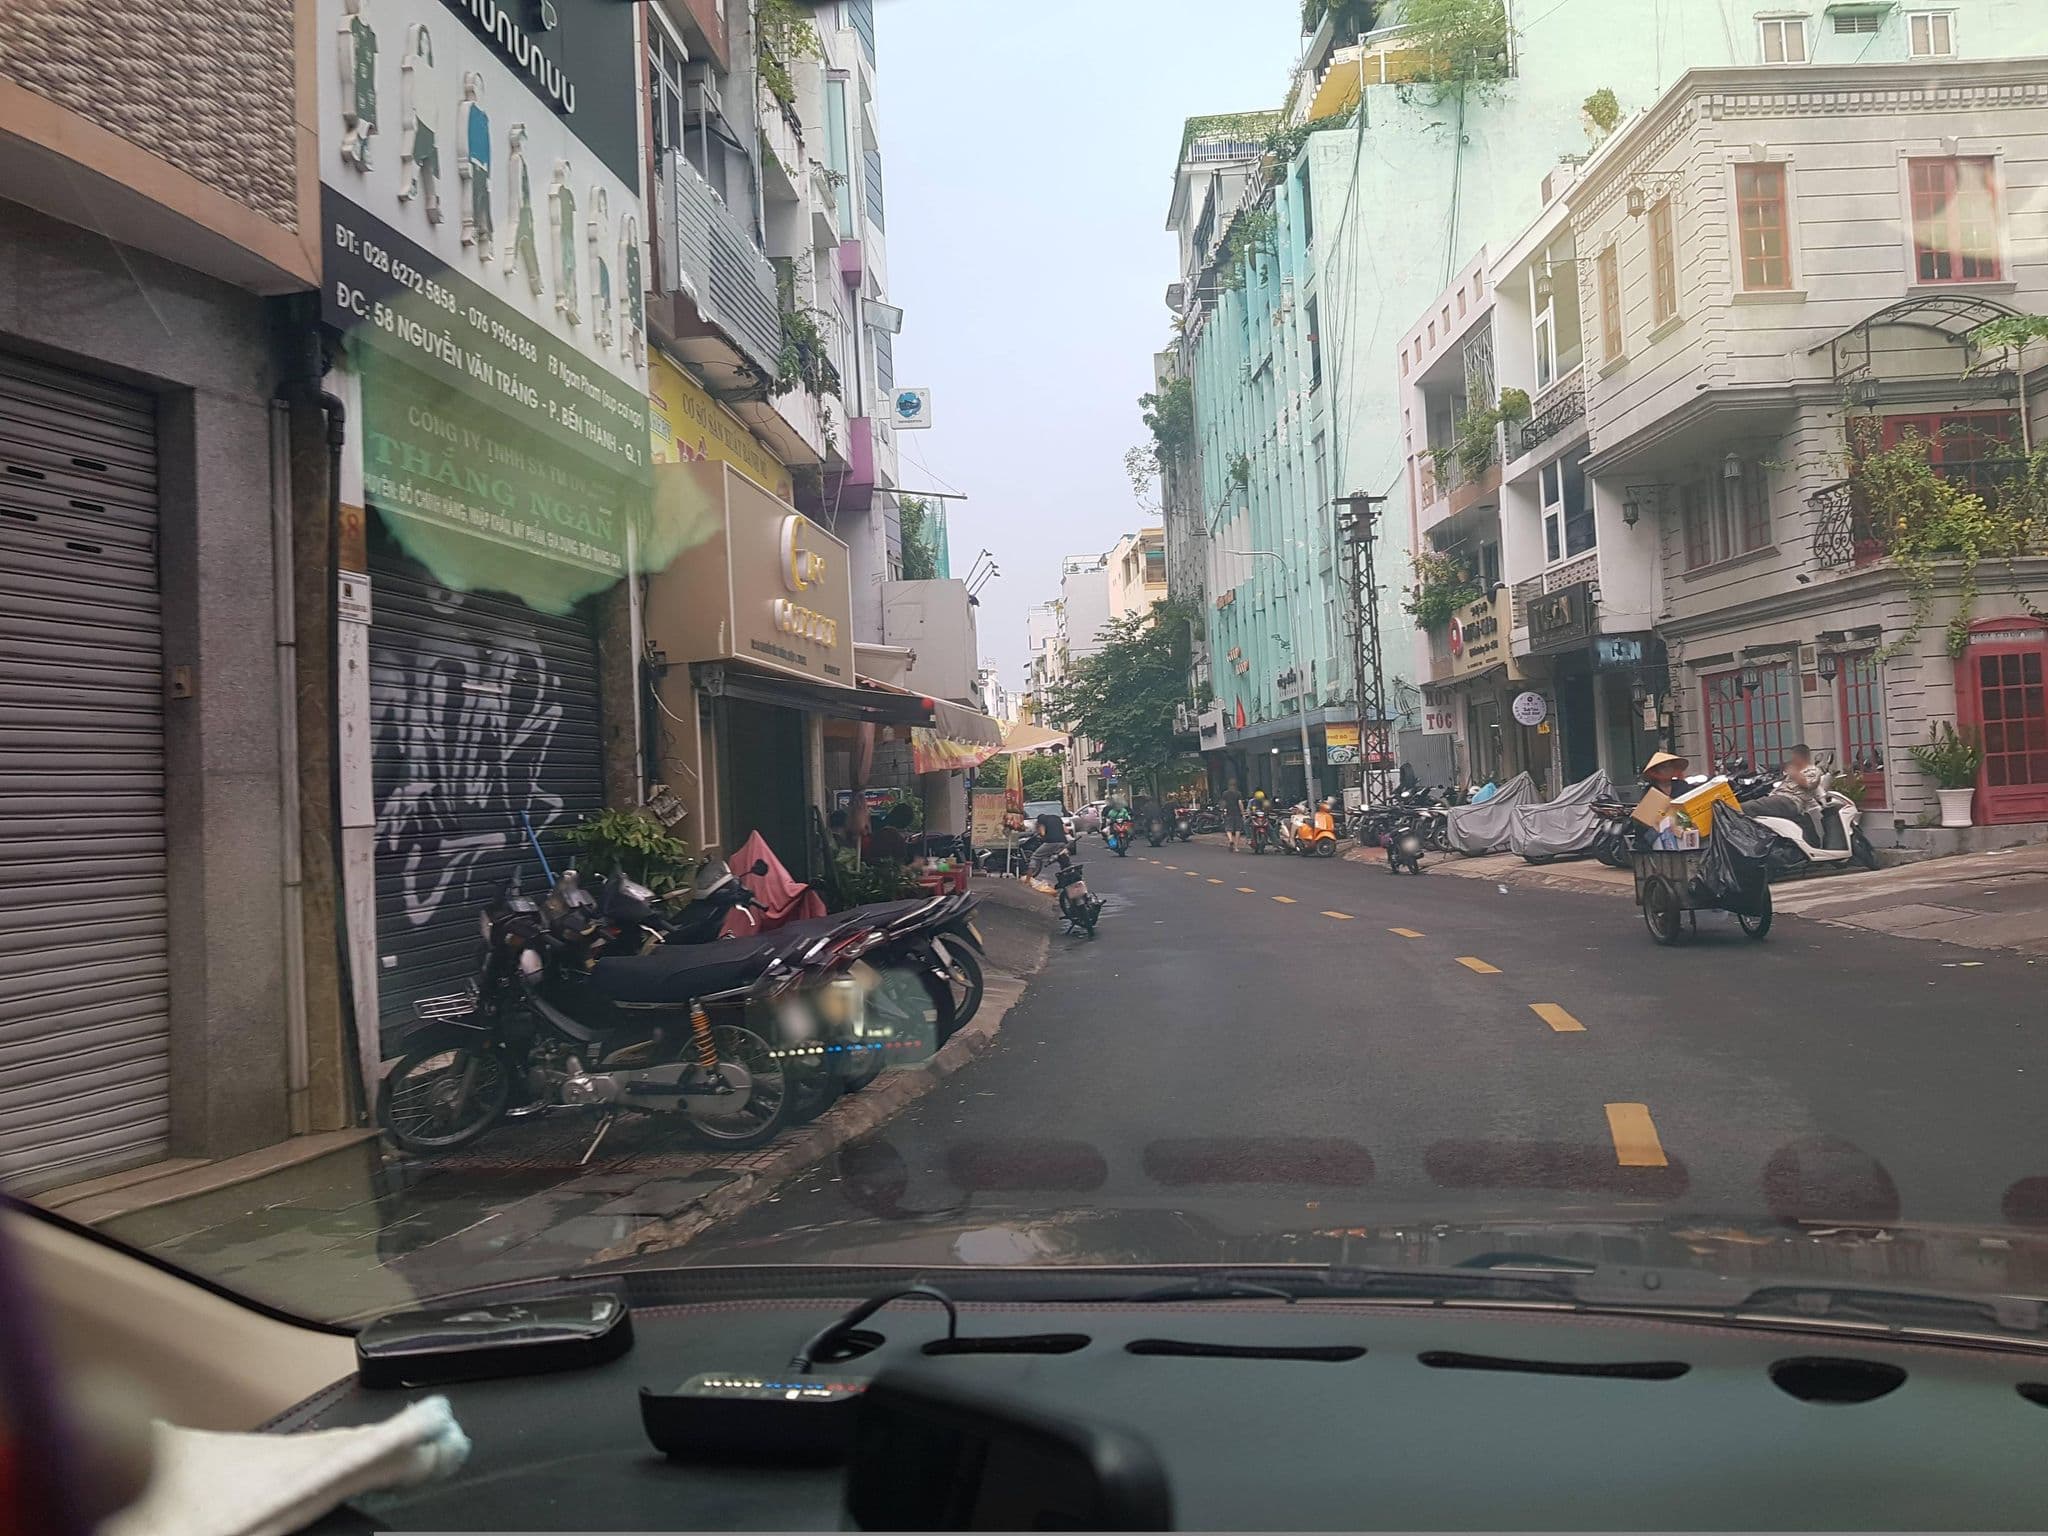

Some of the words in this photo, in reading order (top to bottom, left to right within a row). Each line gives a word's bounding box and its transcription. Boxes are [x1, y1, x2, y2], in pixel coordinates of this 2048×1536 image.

[335, 223, 360, 255] ĐT:
[362, 241, 389, 273] 028
[391, 259, 423, 295] 6272
[425, 278, 457, 314] 5858
[468, 306, 489, 333] 076
[491, 320, 518, 352] 9966
[518, 336, 538, 363] 868
[336, 281, 371, 321] ĐC:
[374, 301, 394, 332] 58
